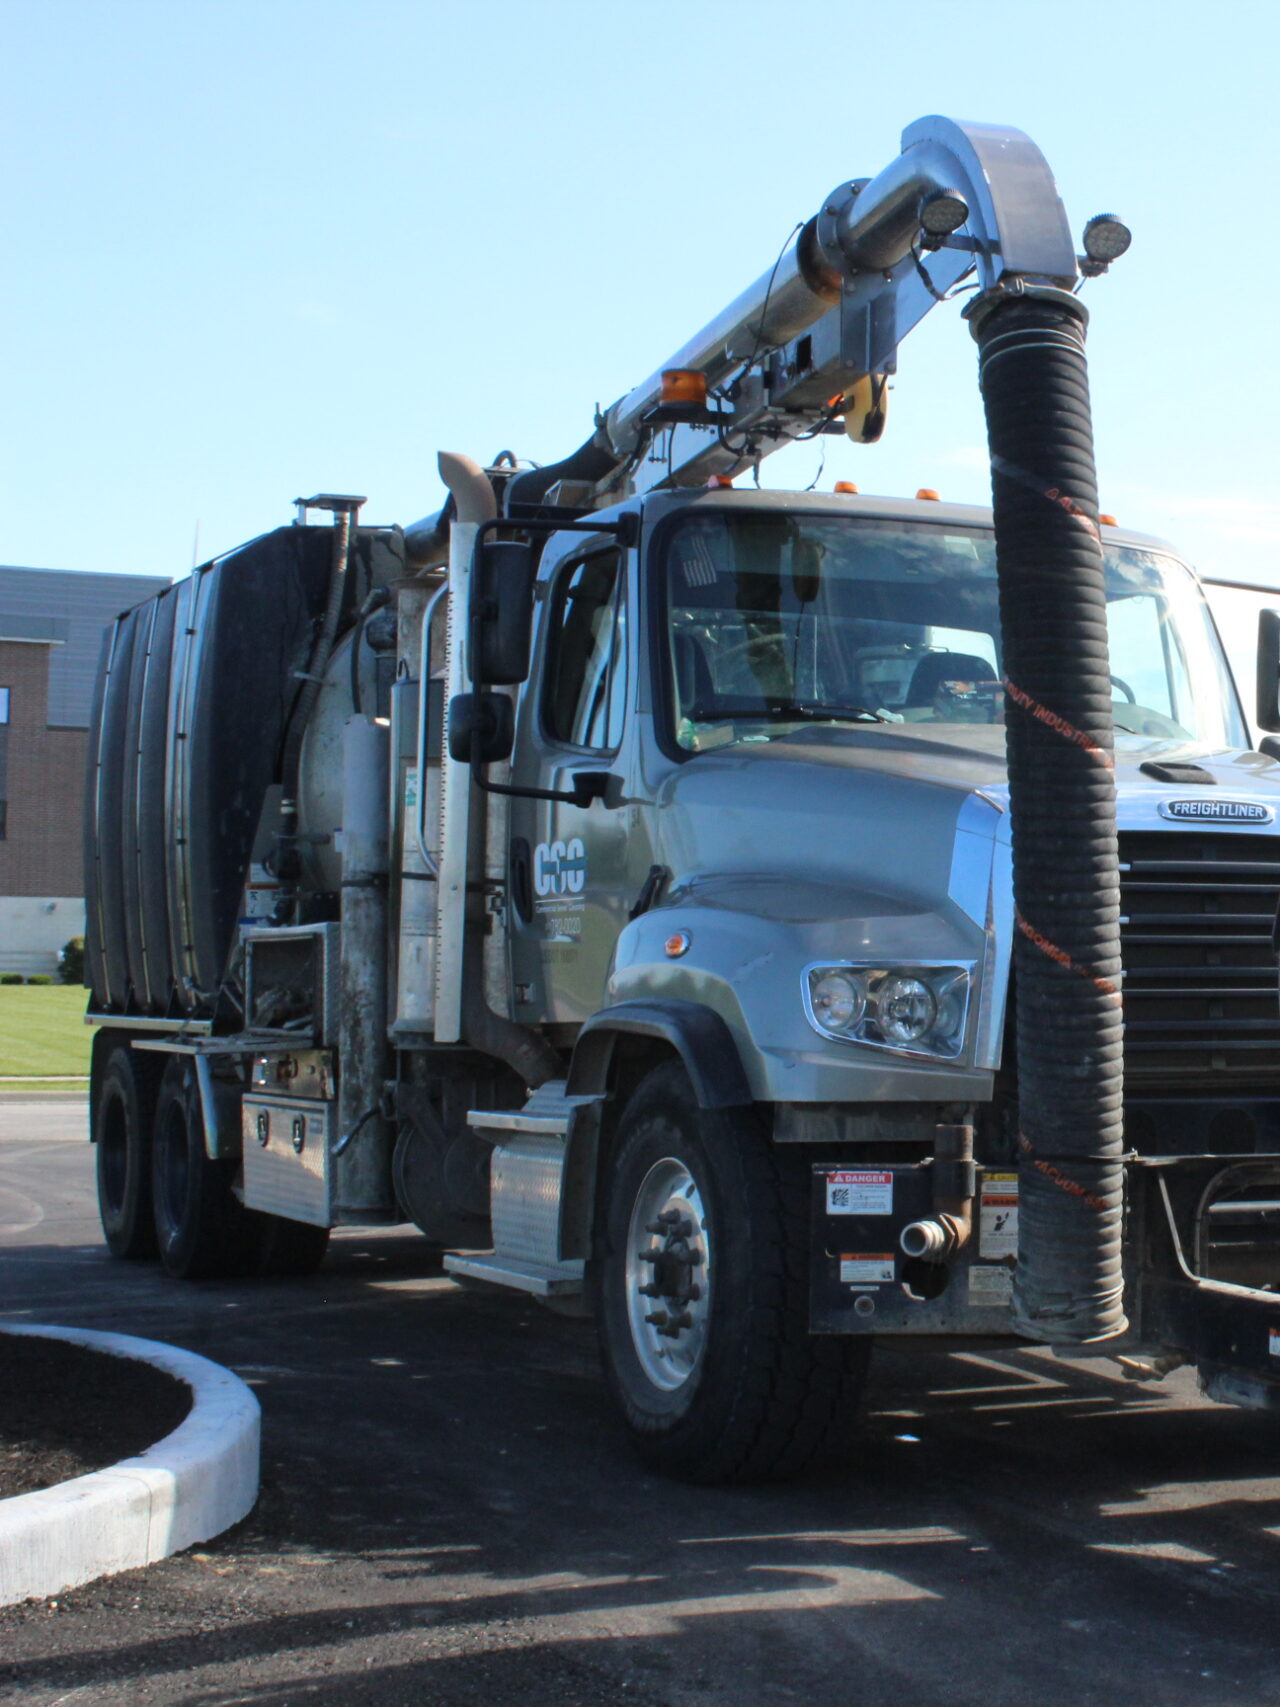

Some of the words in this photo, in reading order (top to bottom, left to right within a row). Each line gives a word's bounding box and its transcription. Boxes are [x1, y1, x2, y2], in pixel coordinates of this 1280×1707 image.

[1174, 803, 1263, 817] FREIGHTLINER
[534, 838, 584, 896] CSC
[845, 1175, 885, 1183] DANGER
